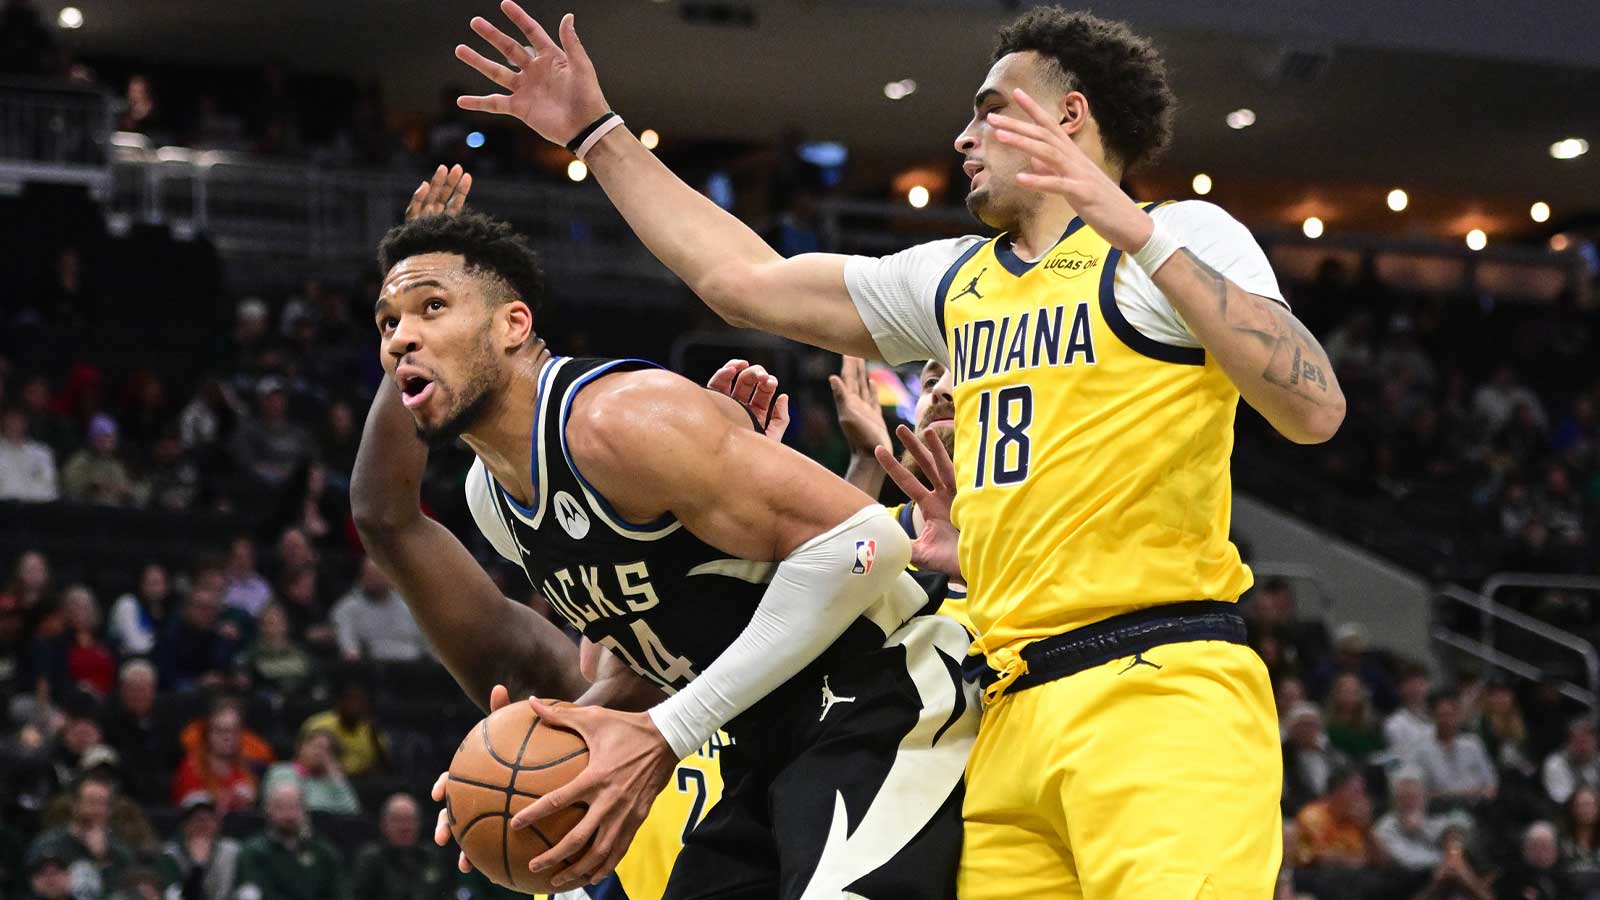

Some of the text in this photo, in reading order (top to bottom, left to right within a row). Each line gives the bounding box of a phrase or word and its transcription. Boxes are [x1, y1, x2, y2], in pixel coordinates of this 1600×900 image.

[1043, 258, 1083, 270] LUCAS
[952, 303, 1096, 387] NDIANA
[974, 385, 1032, 489] 18
[543, 561, 660, 633] UCKS
